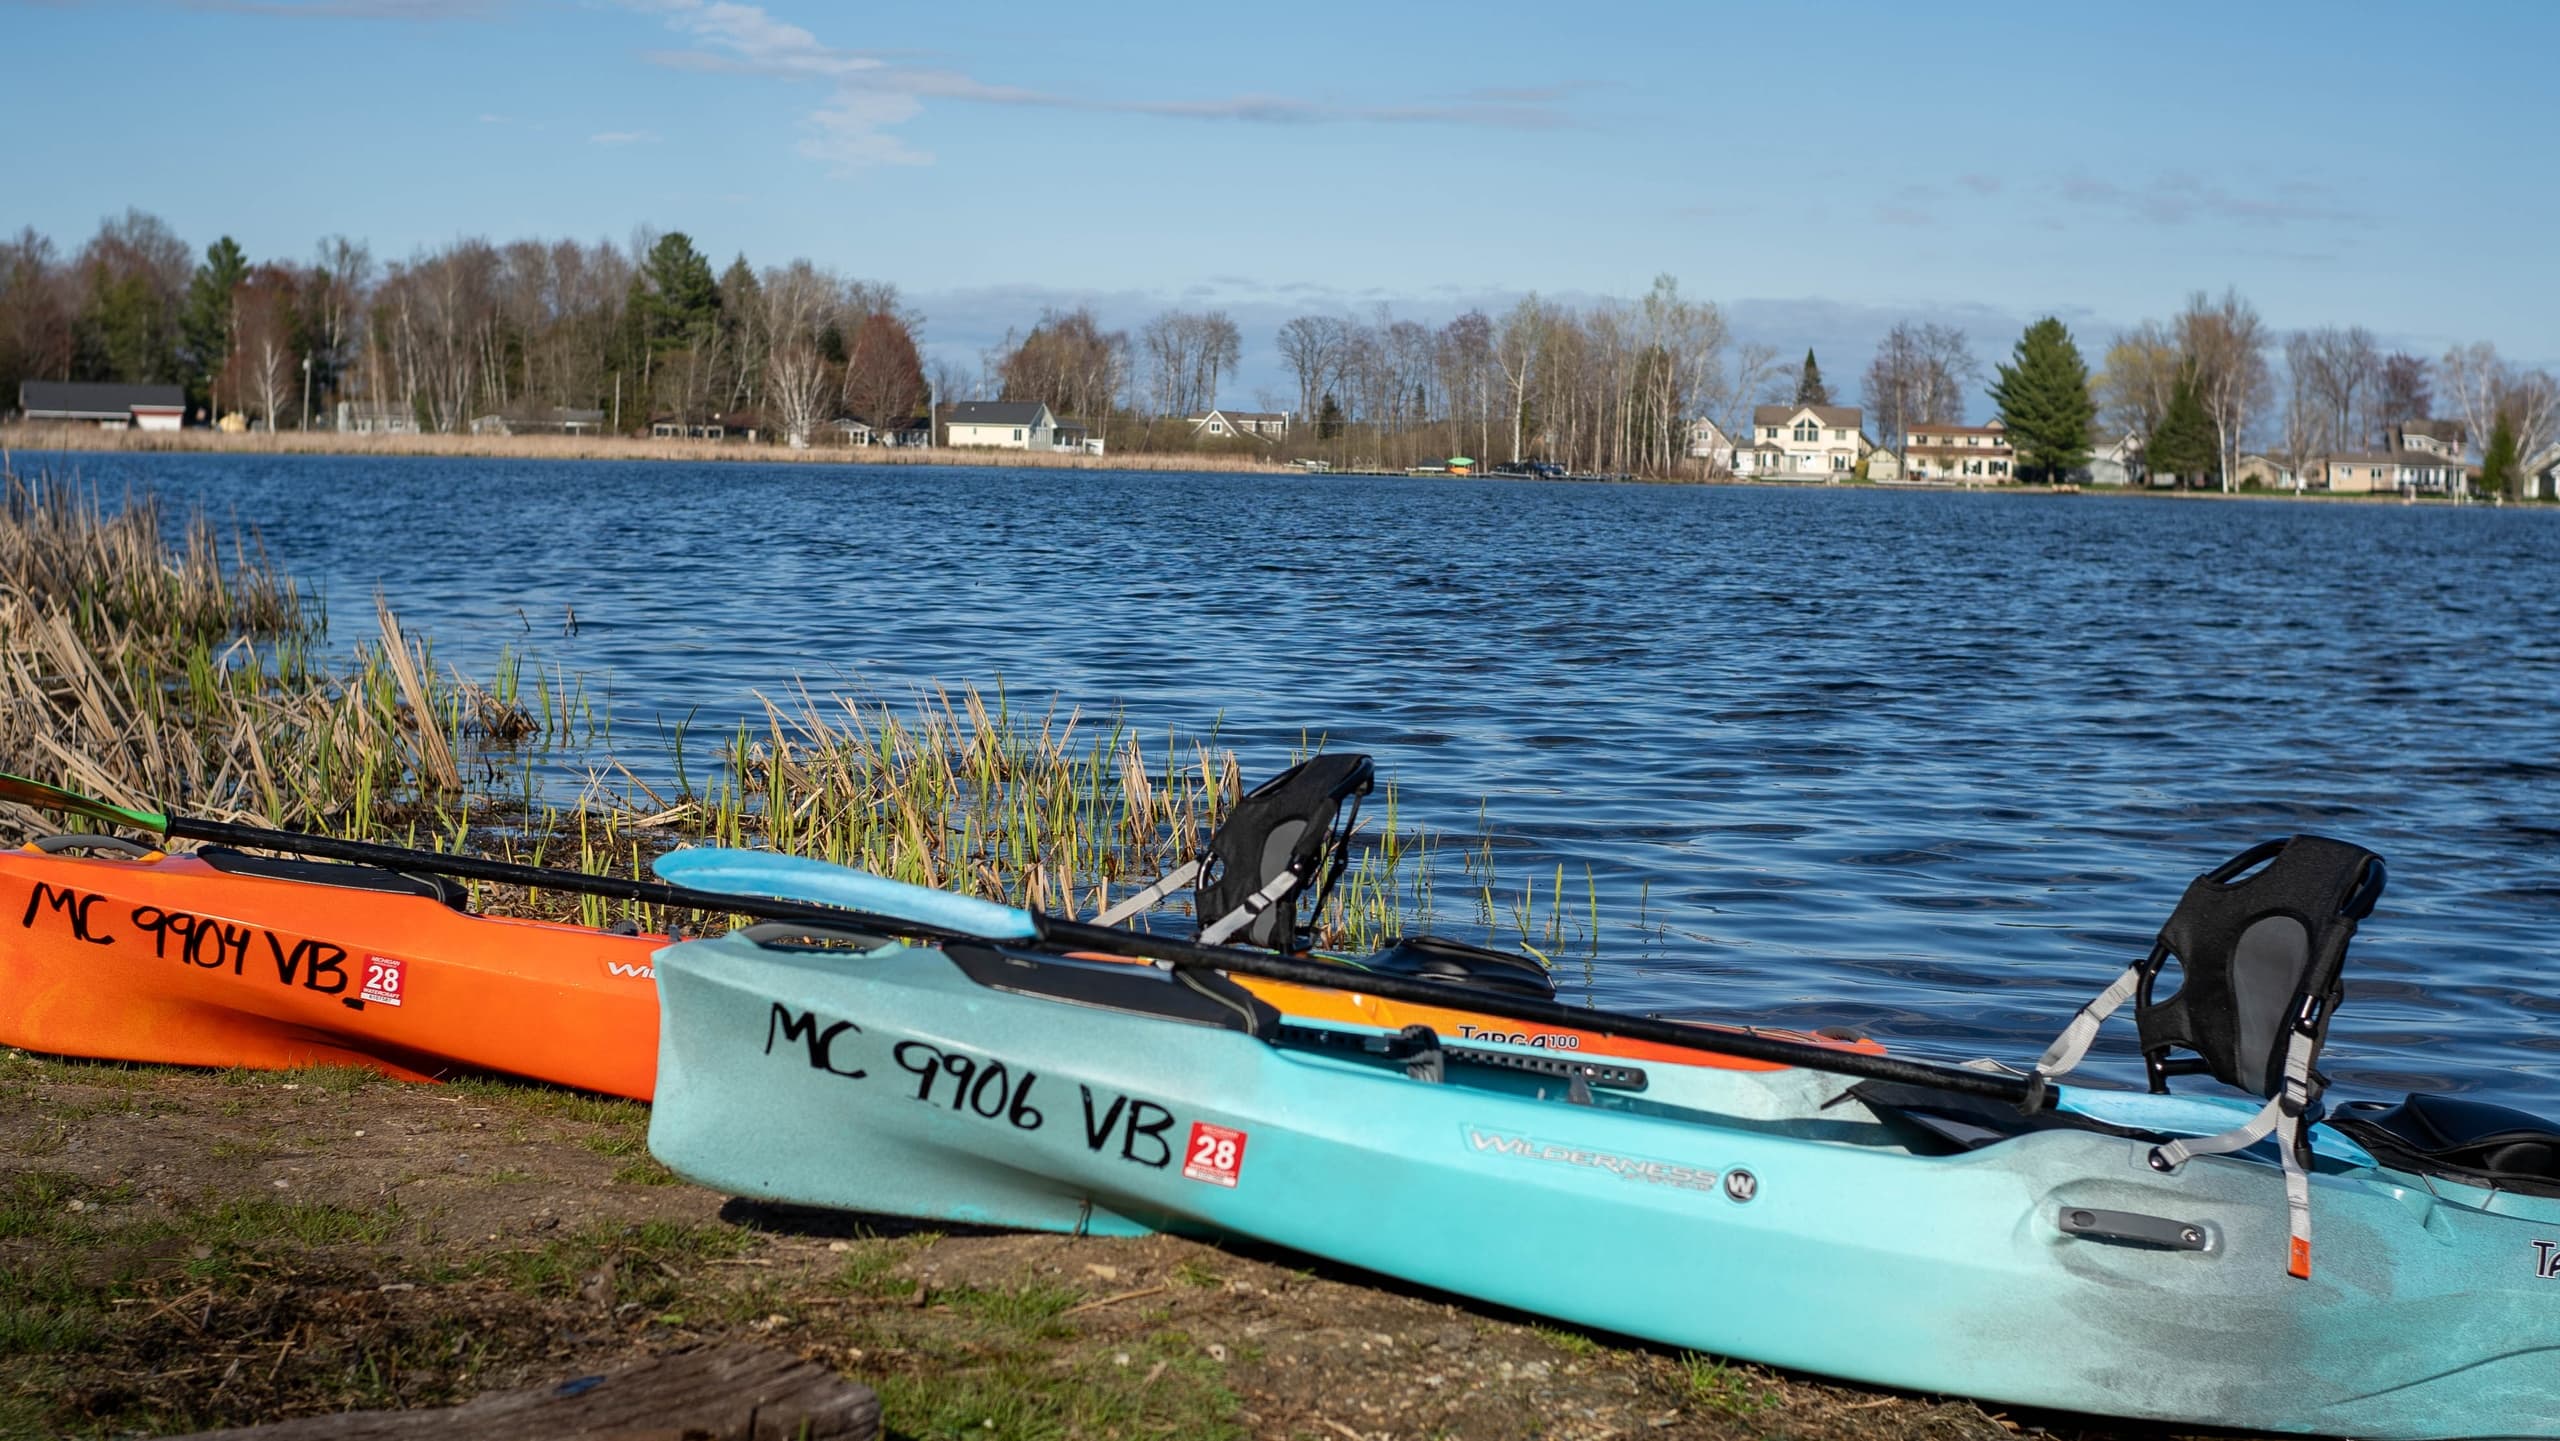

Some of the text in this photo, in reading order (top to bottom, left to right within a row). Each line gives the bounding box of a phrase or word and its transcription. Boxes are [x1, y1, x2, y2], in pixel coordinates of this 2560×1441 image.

[22, 881, 349, 995] MC 9904 VB
[366, 964, 400, 993] 28
[765, 1002, 1176, 1170] MC 9906 VB
[1192, 1134, 1237, 1171] 28
[1470, 1131, 1718, 1185] WILDERNESS
